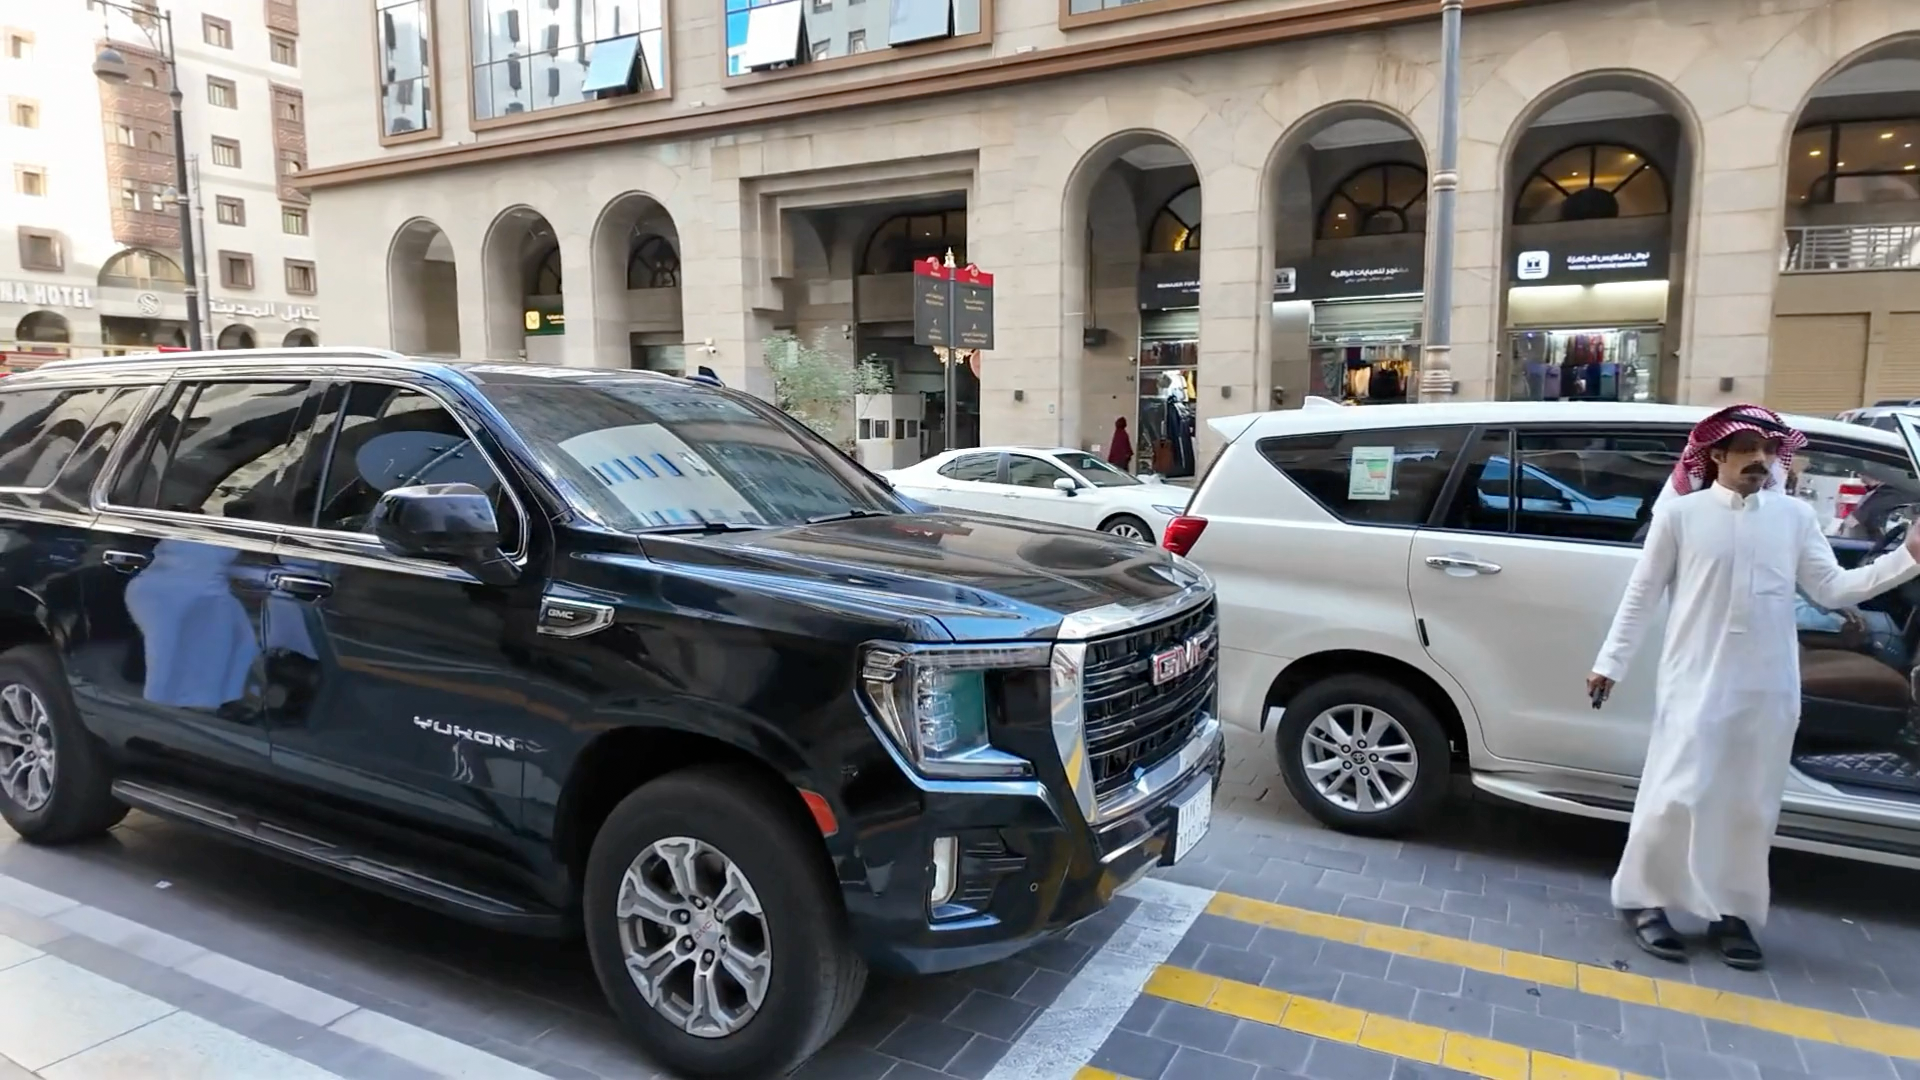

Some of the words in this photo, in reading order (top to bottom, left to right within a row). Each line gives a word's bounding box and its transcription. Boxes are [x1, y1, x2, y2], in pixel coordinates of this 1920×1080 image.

[34, 284, 94, 308] HOTEL
[548, 608, 574, 620] GMC
[1151, 633, 1211, 685] GMC
[413, 715, 516, 752] YUKON
[694, 920, 713, 939] GMC
